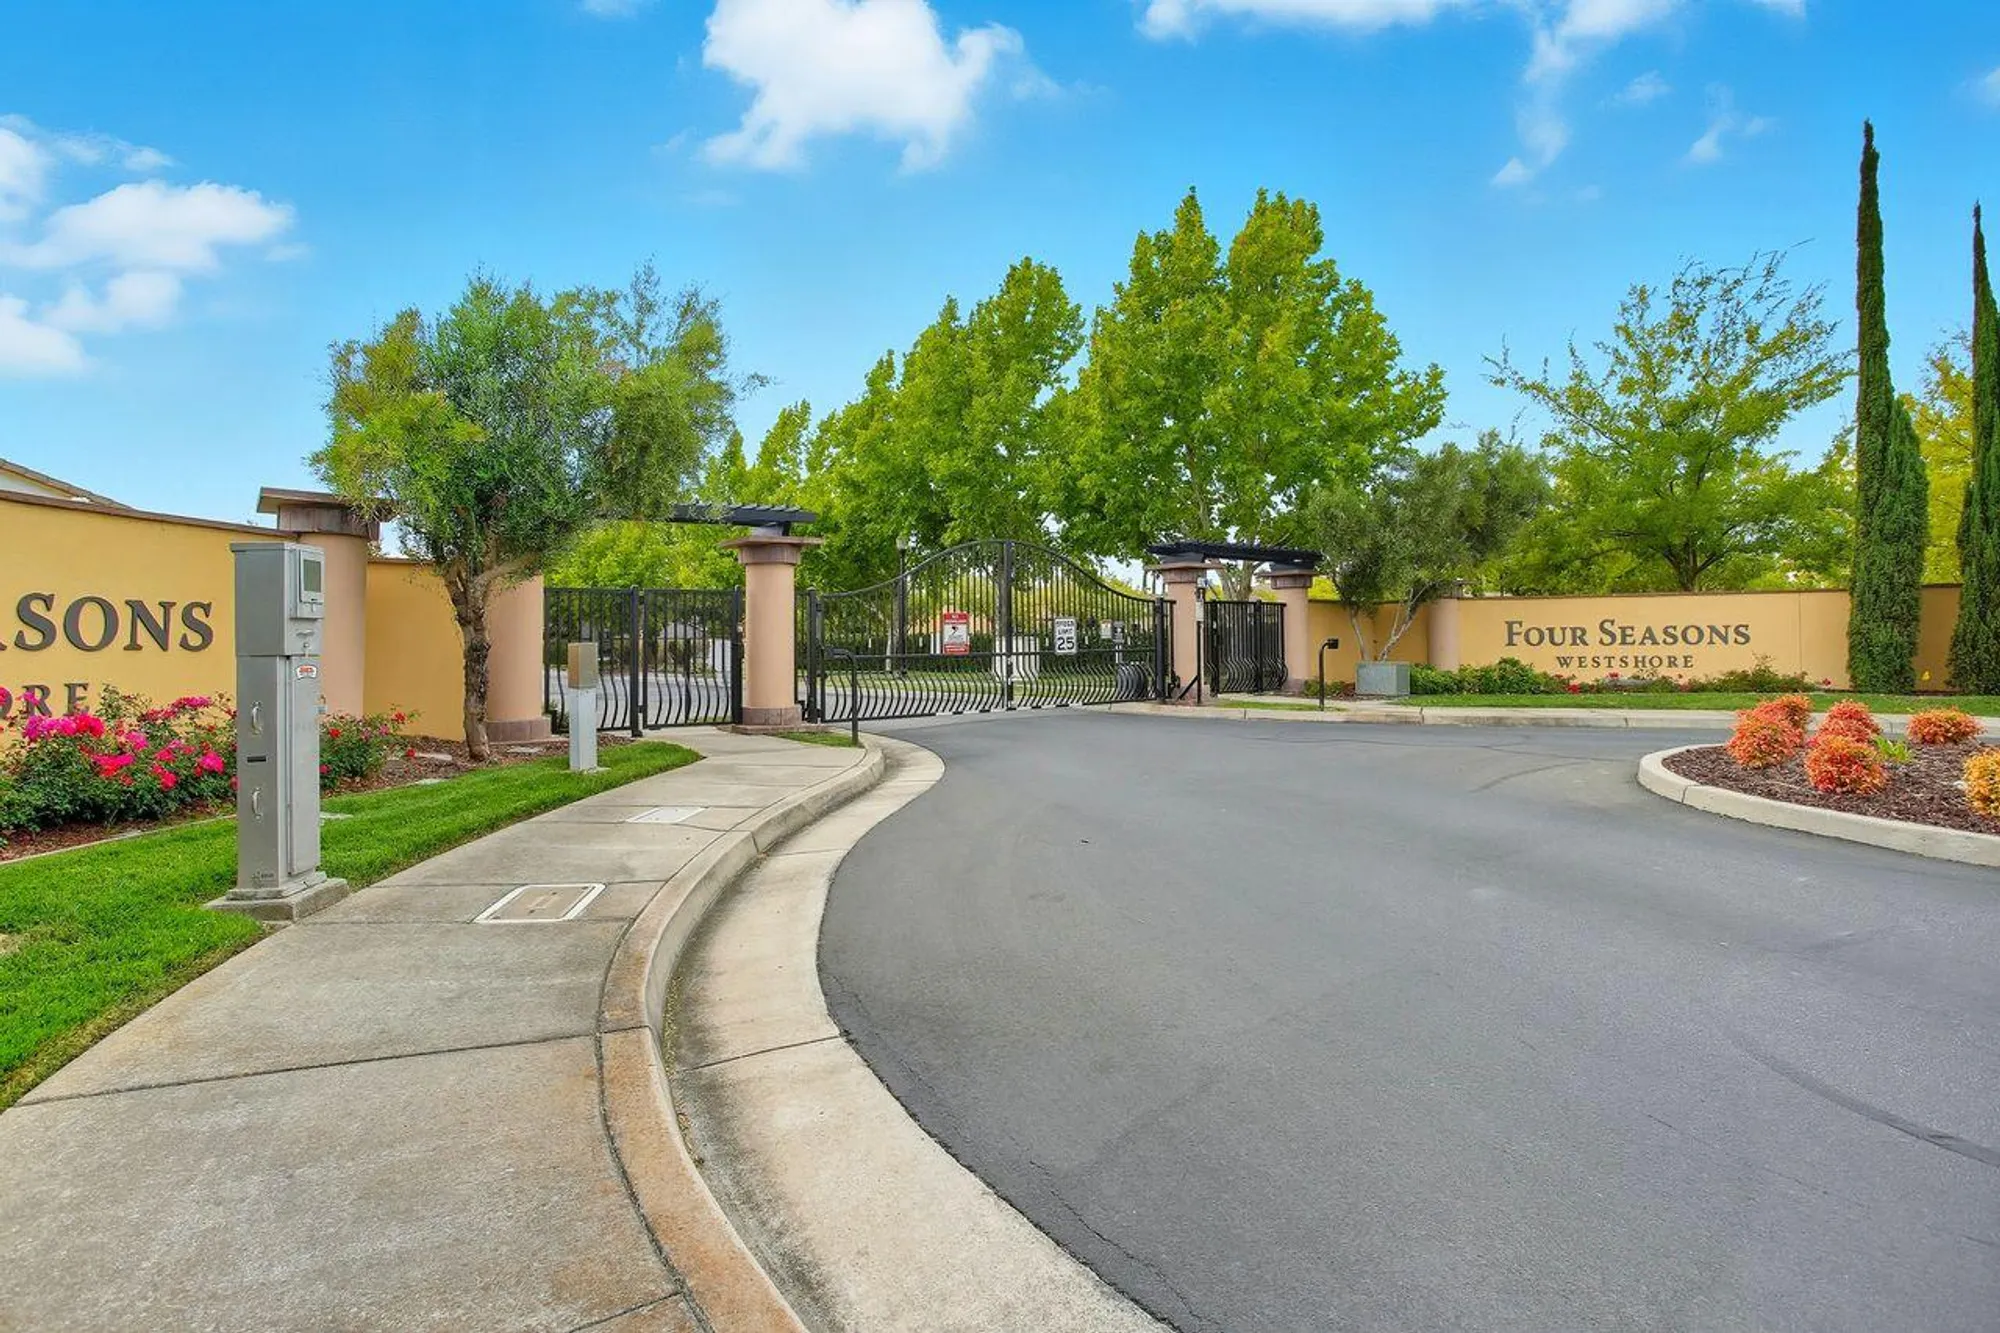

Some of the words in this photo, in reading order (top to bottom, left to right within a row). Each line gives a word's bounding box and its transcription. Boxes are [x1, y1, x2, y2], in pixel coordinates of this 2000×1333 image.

[0, 592, 214, 652] SONS
[1504, 620, 1589, 647] FOUR
[1598, 618, 1752, 647] SEASONS
[1057, 636, 1075, 651] 25
[1556, 654, 1695, 669] WESTSHORE
[0, 683, 90, 721] RE
